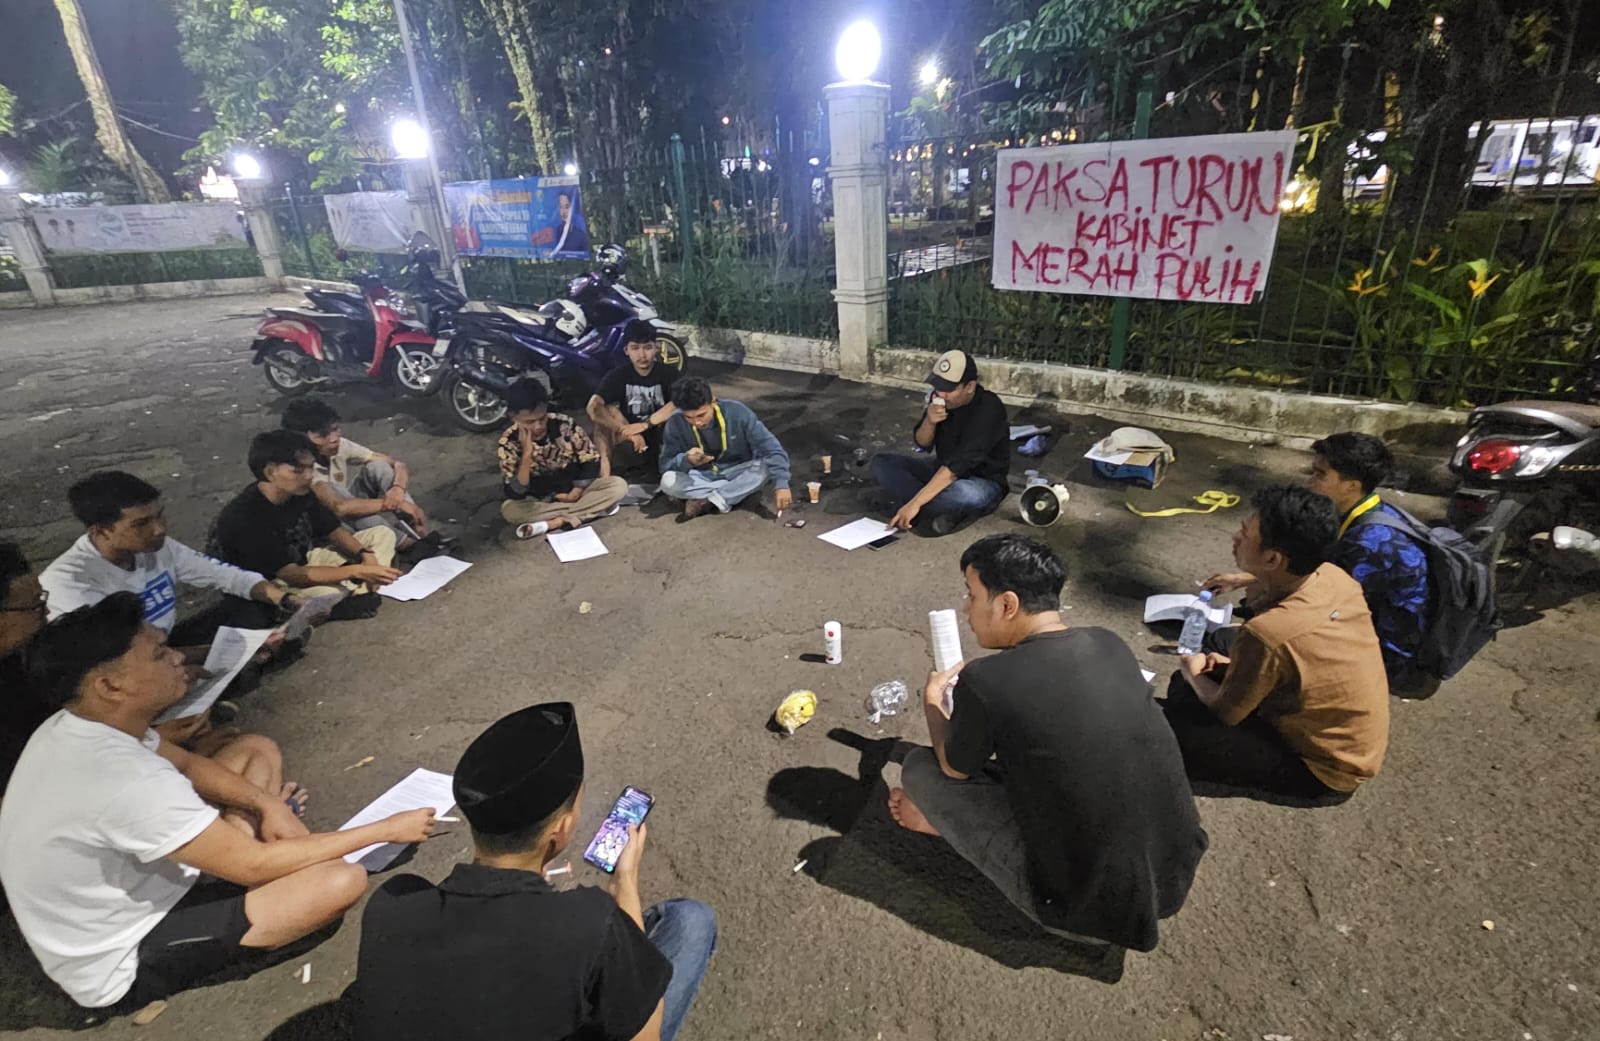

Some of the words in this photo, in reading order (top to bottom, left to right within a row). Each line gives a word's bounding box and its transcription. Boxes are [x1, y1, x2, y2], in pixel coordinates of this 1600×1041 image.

[1007, 157, 1128, 214] PAKSA
[1140, 151, 1283, 223] TURUN
[1011, 239, 1138, 291] MERAH
